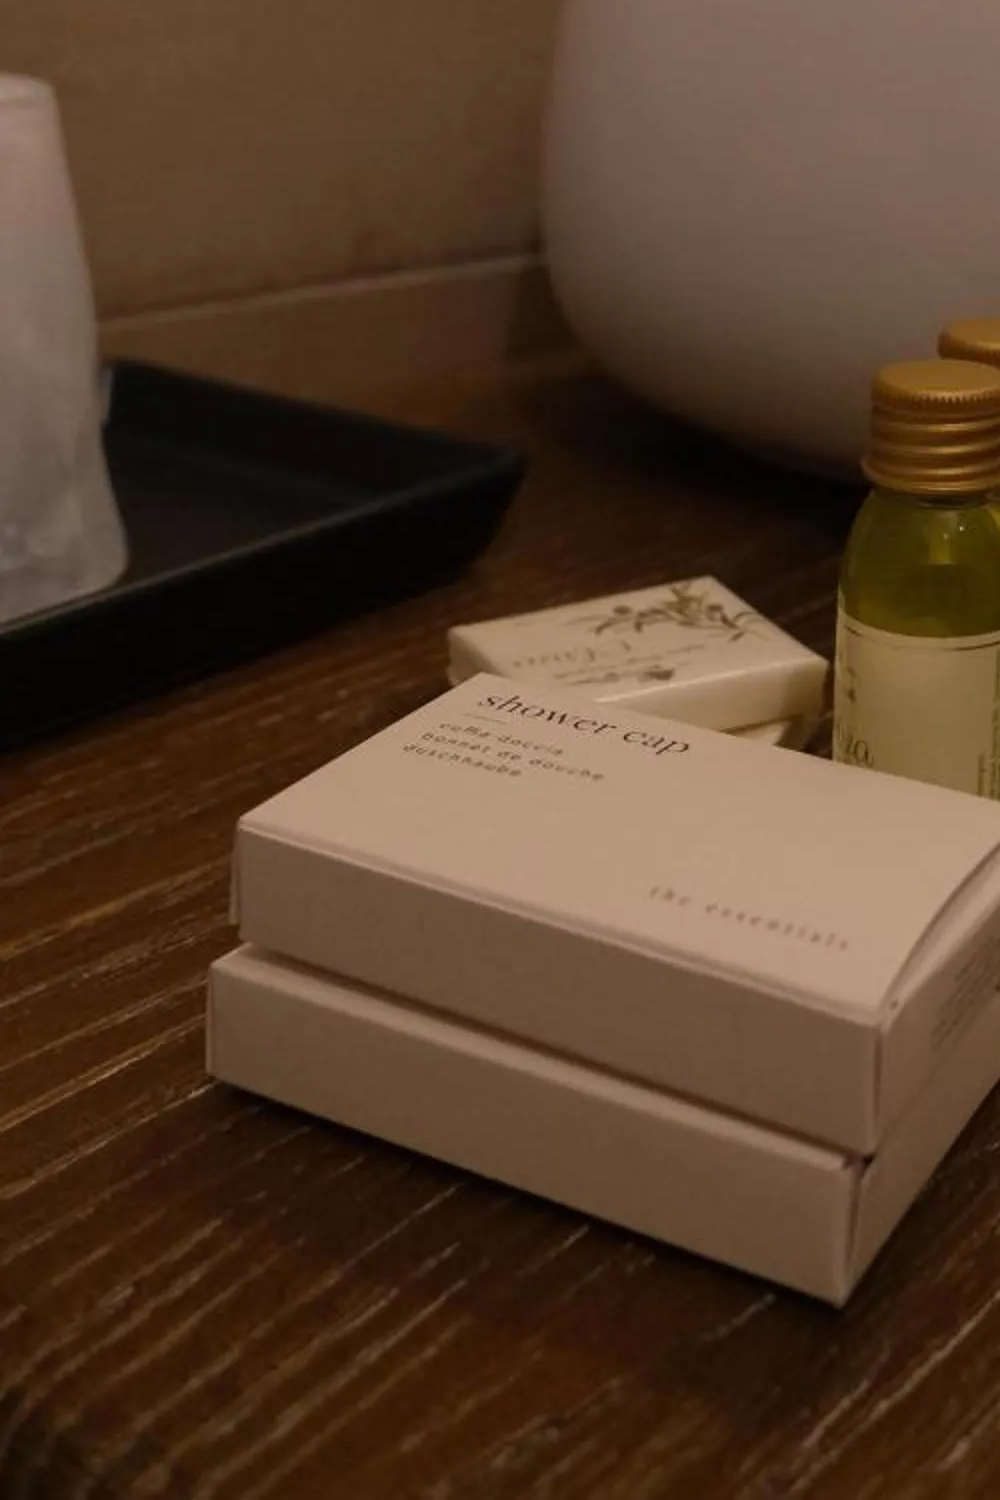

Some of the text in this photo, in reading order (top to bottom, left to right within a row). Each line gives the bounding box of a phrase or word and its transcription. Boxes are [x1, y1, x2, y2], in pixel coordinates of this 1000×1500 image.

[477, 695, 690, 755] shower cap
[403, 743, 521, 777] duschhaube
[421, 731, 605, 780] bonnet de douche
